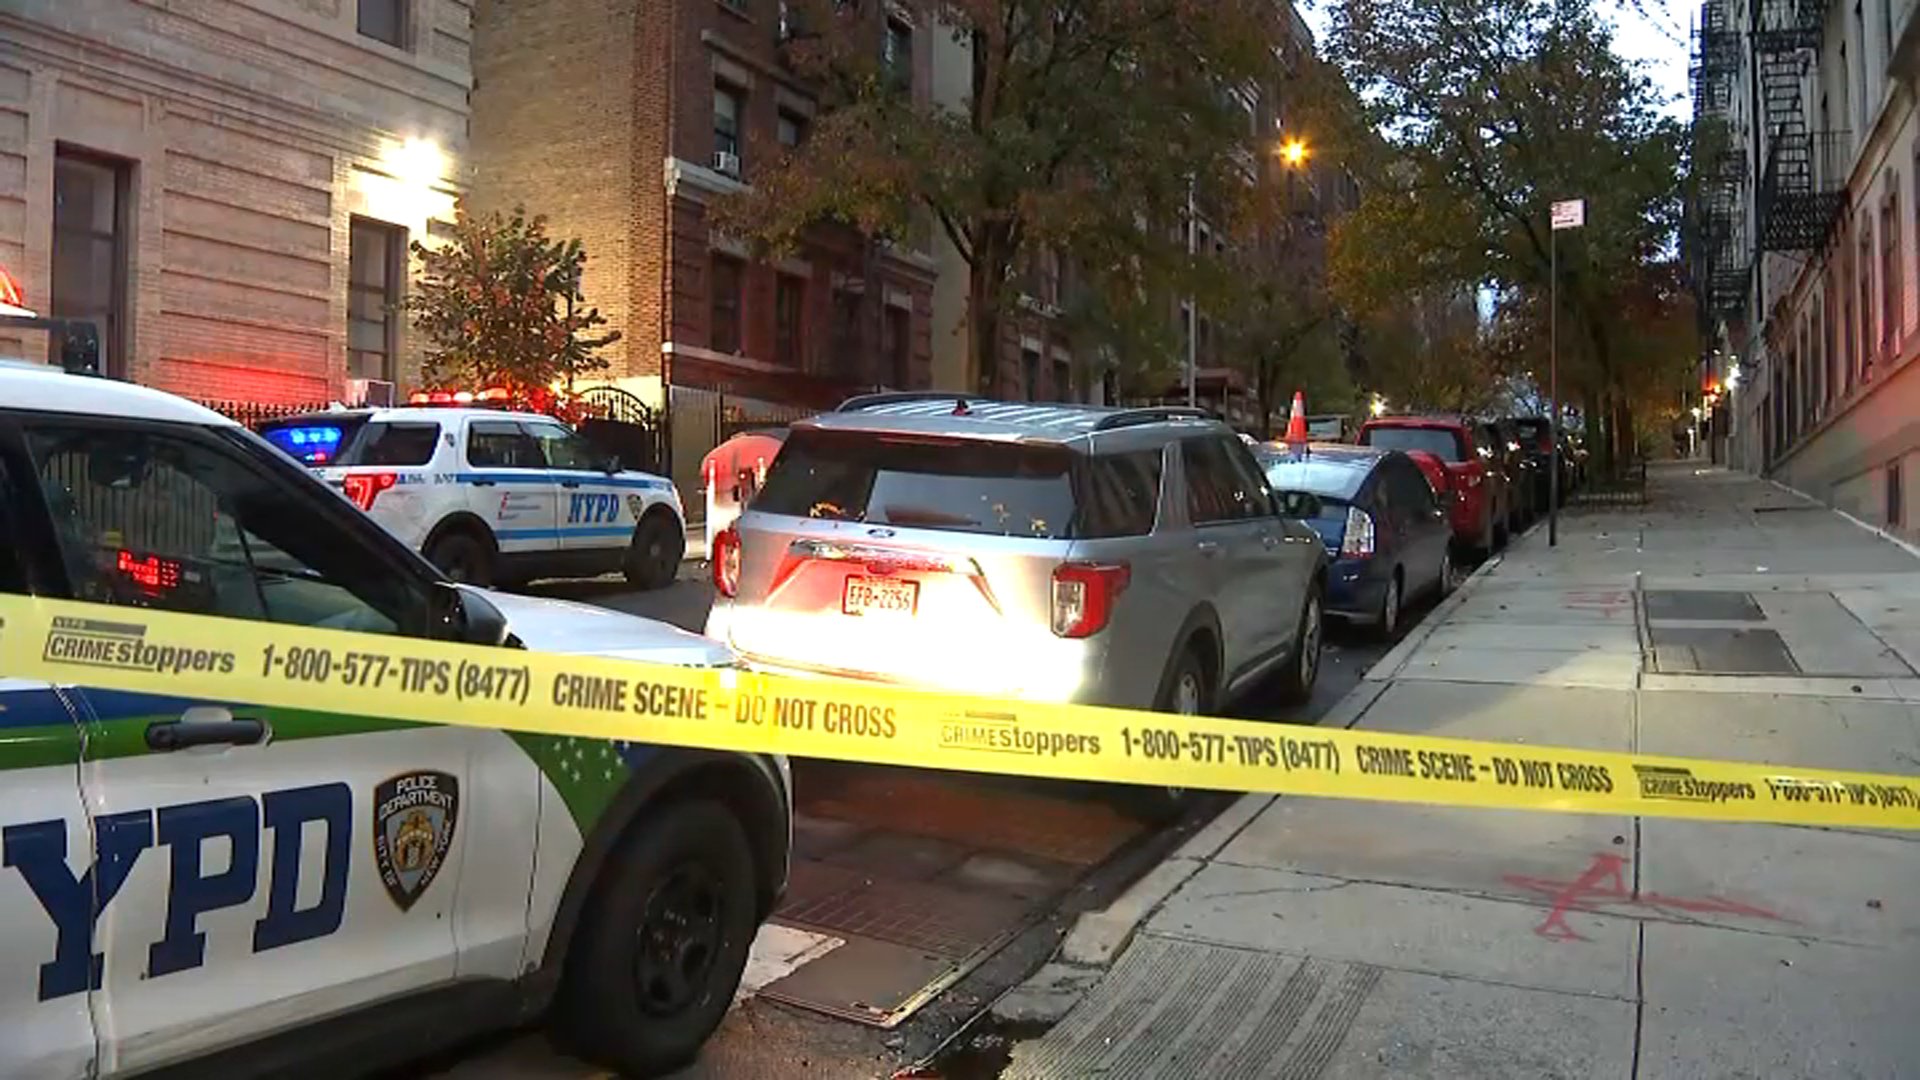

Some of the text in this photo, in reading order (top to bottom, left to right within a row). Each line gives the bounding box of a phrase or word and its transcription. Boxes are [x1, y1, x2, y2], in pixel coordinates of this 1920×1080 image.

[568, 493, 619, 522] NYPD
[262, 644, 451, 695] 1-800-577-TIPS
[455, 661, 531, 706] (8477)
[552, 673, 628, 712] CRIME
[633, 681, 708, 720] SCENE
[735, 693, 767, 726] DO
[773, 698, 816, 732] NOT
[823, 702, 897, 739] CROSS
[1121, 727, 1277, 768] 1-800-577-TIPS
[1281, 738, 1341, 775] (8477)
[1356, 745, 1414, 779] CRIME
[1418, 750, 1477, 784] SCENE
[1493, 757, 1520, 786] DO
[1522, 758, 1555, 790] NOT
[1558, 762, 1614, 794] CROSS
[396, 775, 438, 794] POLICE
[380, 790, 454, 820] DEPARTMENT
